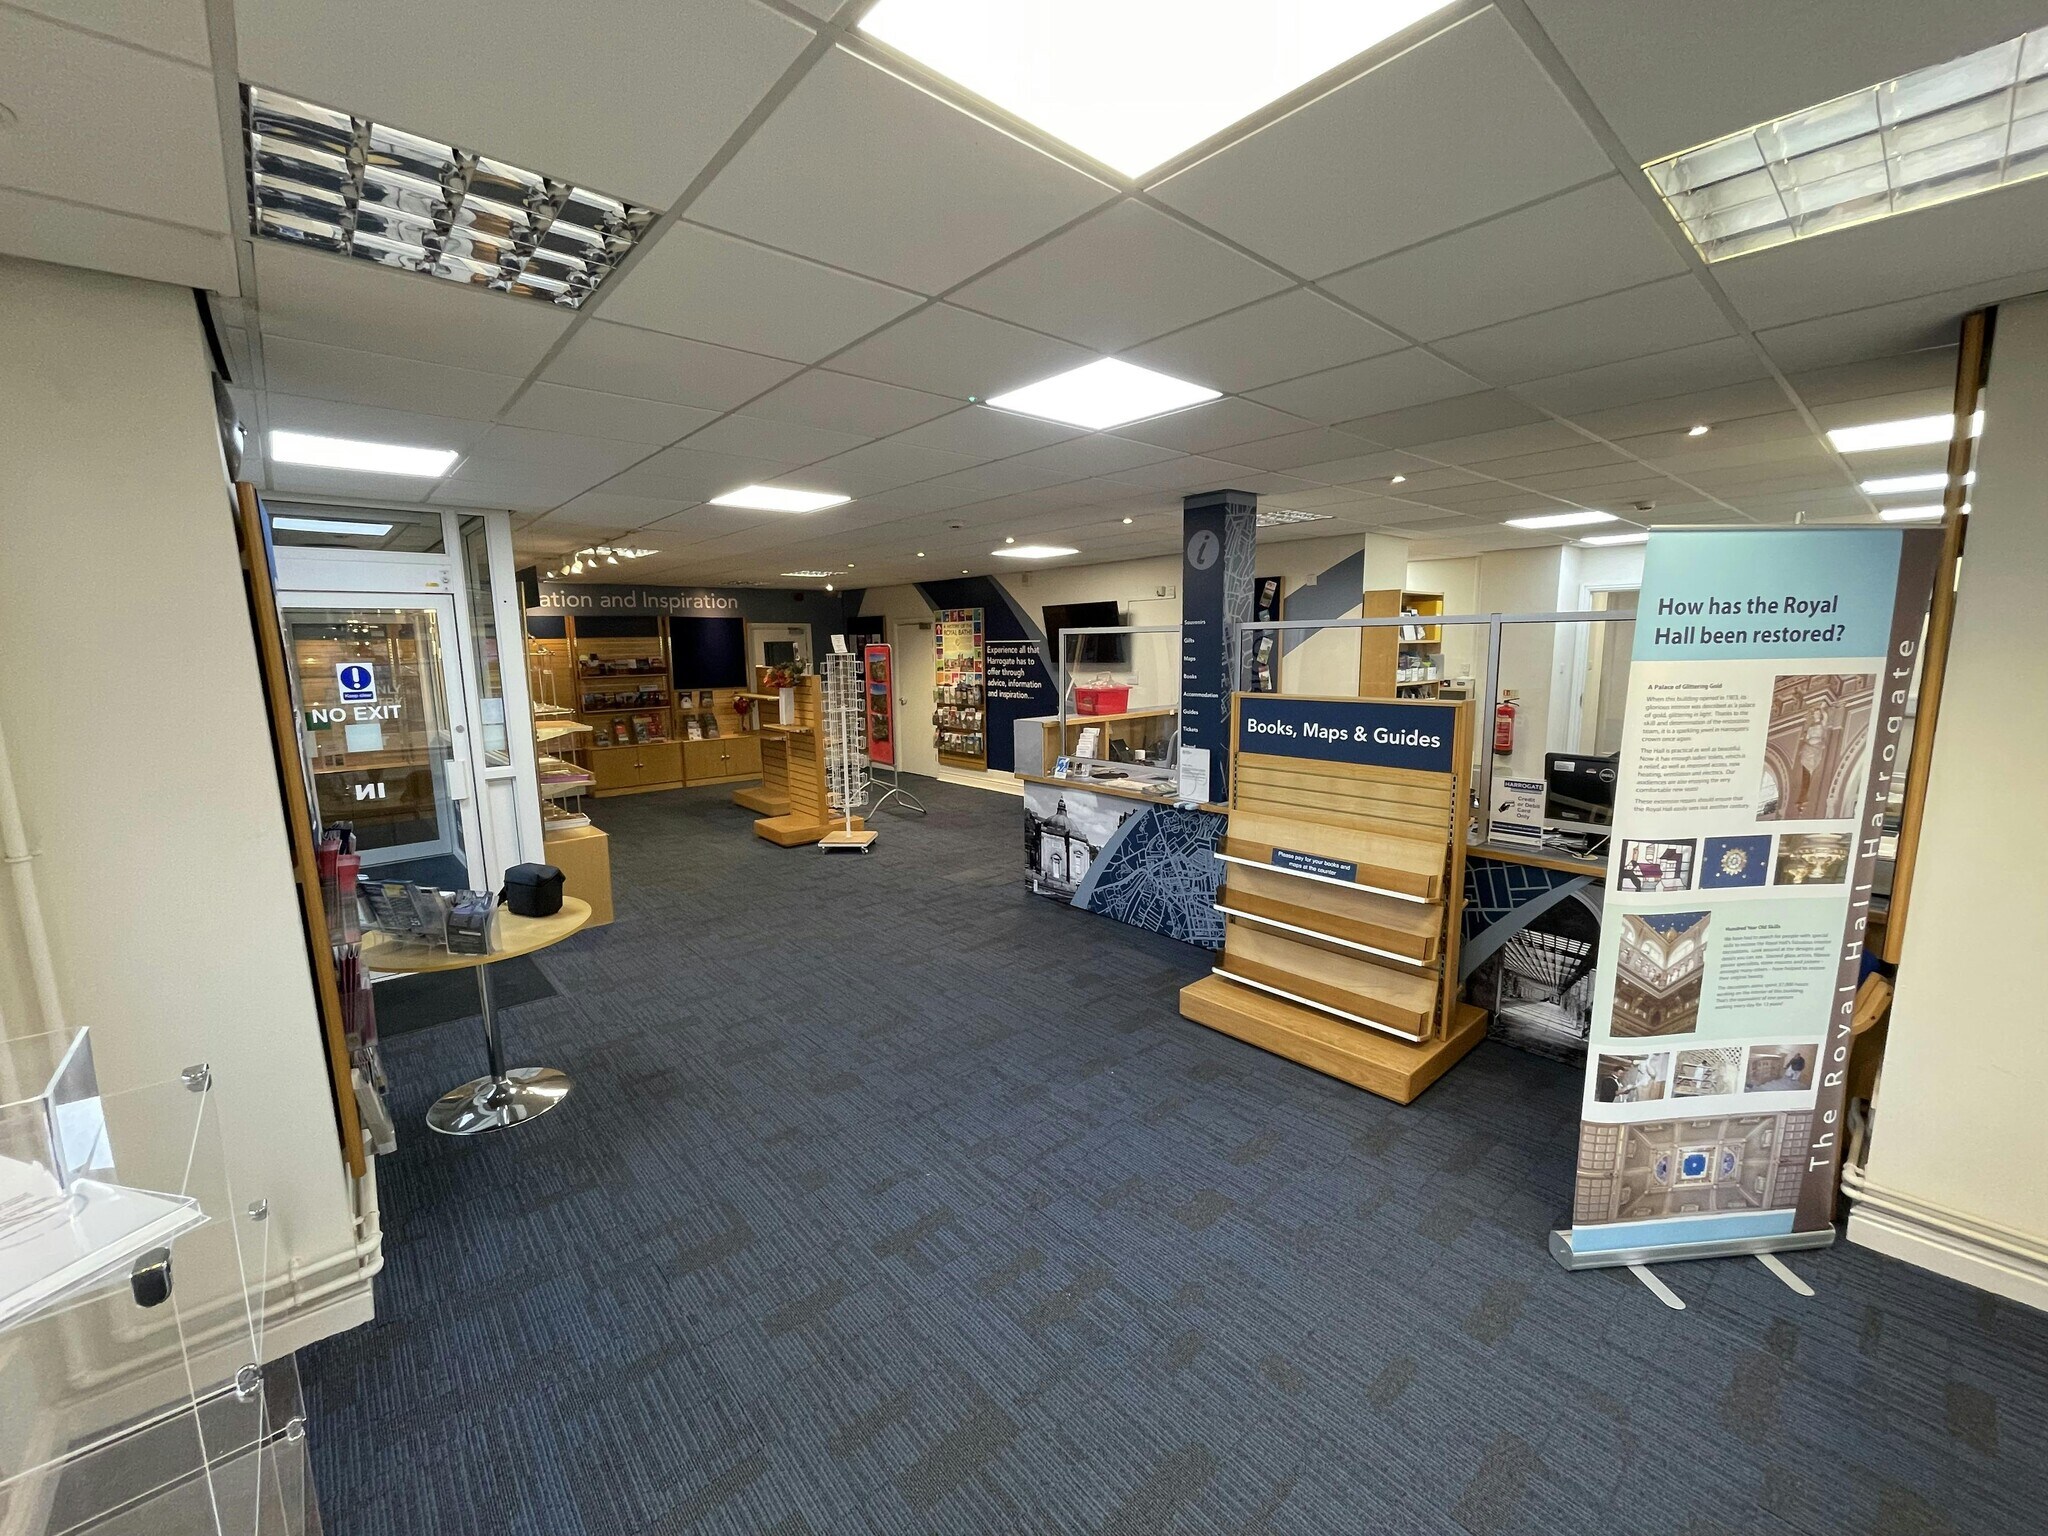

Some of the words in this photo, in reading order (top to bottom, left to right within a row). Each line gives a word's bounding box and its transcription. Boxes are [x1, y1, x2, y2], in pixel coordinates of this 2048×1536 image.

[600, 590, 636, 608] and
[643, 591, 738, 614] Inspiration
[1658, 598, 1704, 615] How
[1708, 596, 1741, 614] has
[1747, 596, 1778, 614] the
[1784, 595, 1838, 618] Royal
[1654, 626, 1695, 644] Hall
[1700, 626, 1747, 644] been
[1752, 624, 1846, 643] restored?
[987, 646, 1018, 655] Experience
[1027, 646, 1040, 654] that
[987, 657, 1015, 666] Harrogate
[1016, 657, 1026, 665] has
[987, 667, 1000, 675] offer
[1002, 668, 1025, 678] through
[988, 678, 1007, 687] advice,
[1008, 678, 1042, 688] information
[377, 684, 401, 694] NLY
[312, 707, 347, 724] NO
[354, 705, 402, 721] EXIT
[1247, 718, 1298, 738] Books,
[1303, 722, 1349, 743] Maps
[1353, 726, 1368, 742] &
[1373, 727, 1441, 748] Guides
[1505, 781, 1542, 790] HARROGATE
[1278, 851, 1294, 859] Please
[1808, 1109, 1837, 1173] The
[1824, 985, 1856, 1087] Royal
[1844, 884, 1872, 961] Hall
[1862, 640, 1914, 859] Harrogate
